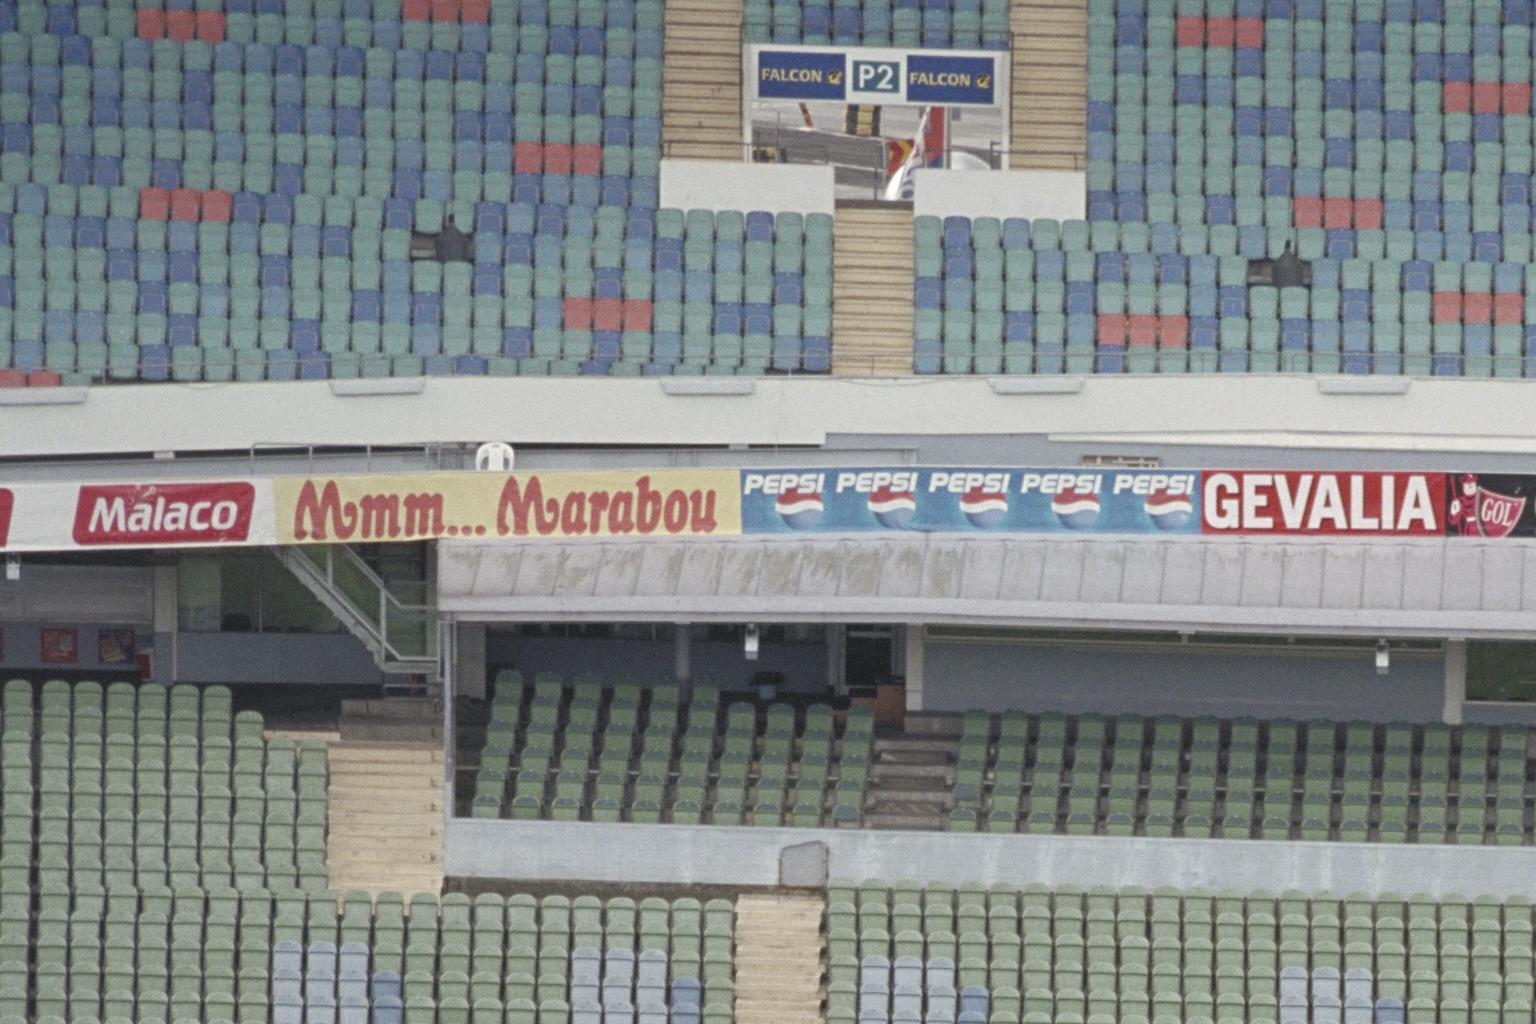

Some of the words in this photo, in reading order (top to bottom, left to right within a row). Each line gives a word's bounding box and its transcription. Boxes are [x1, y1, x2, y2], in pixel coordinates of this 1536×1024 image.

[761, 68, 822, 83] FALCON
[858, 64, 893, 90] P2
[909, 71, 970, 87] FALCON
[744, 472, 825, 495] PEPSI
[836, 471, 918, 494] PEPSI
[928, 472, 1010, 494] PEPSI
[1020, 473, 1102, 495] PEPSI
[1113, 474, 1195, 495] PEPSI
[88, 496, 238, 532] Malaco
[295, 479, 487, 540] Mmm...
[497, 475, 718, 536] Marabou
[1204, 474, 1437, 531] GEVALIA
